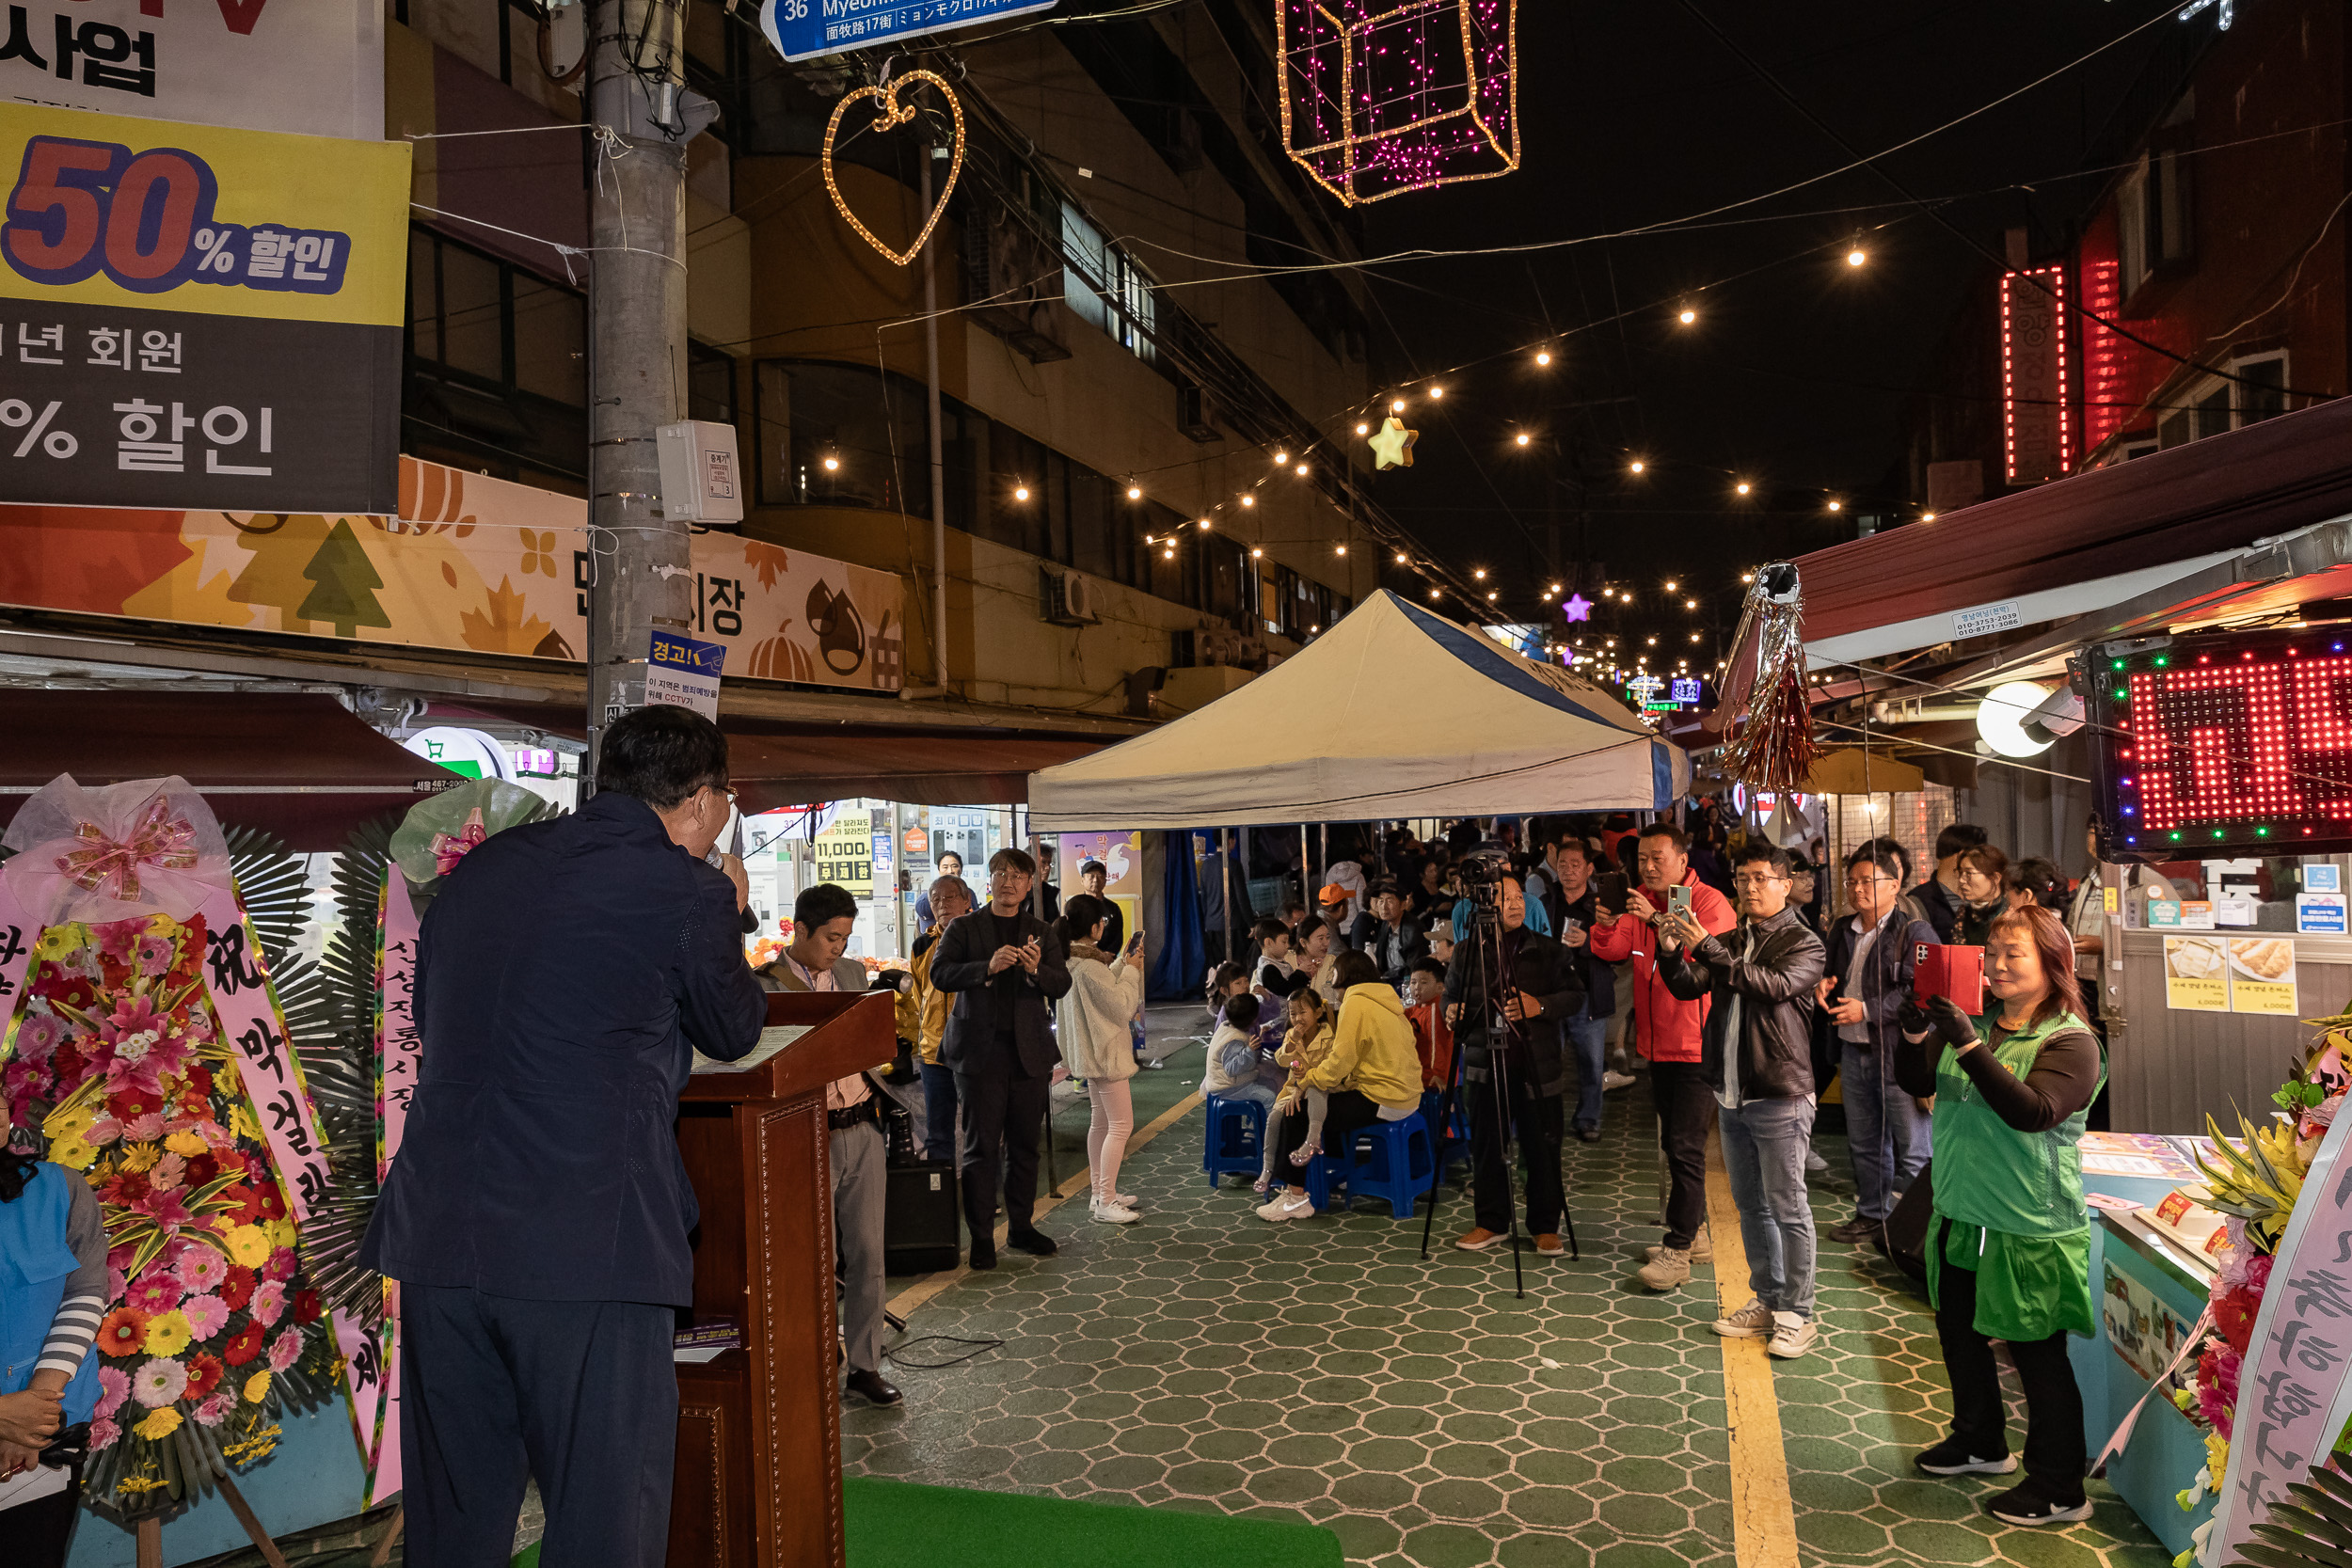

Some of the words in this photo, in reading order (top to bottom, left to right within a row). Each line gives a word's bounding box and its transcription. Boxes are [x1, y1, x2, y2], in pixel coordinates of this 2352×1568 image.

[785, 0, 808, 21] 36
[822, 0, 898, 17] Myeon
[900, 0, 1011, 24] ミョンモクロ17キ
[826, 14, 892, 40] 面牧路17街
[0, 5, 156, 98] 사업
[8, 140, 235, 279] 50%
[247, 230, 335, 281] 할인
[87, 326, 182, 373] 회원
[113, 398, 272, 476] 할인
[1958, 612, 2017, 630] 010-3753-2039
[1959, 619, 2019, 636] 010-8771-3086
[654, 641, 691, 664] 경고!
[648, 690, 663, 700] 위해
[665, 693, 693, 705] CCTV가
[649, 678, 657, 687] 이
[659, 680, 679, 691] 지역은
[682, 685, 718, 698] 범죄예방을
[207, 924, 265, 996] 祝
